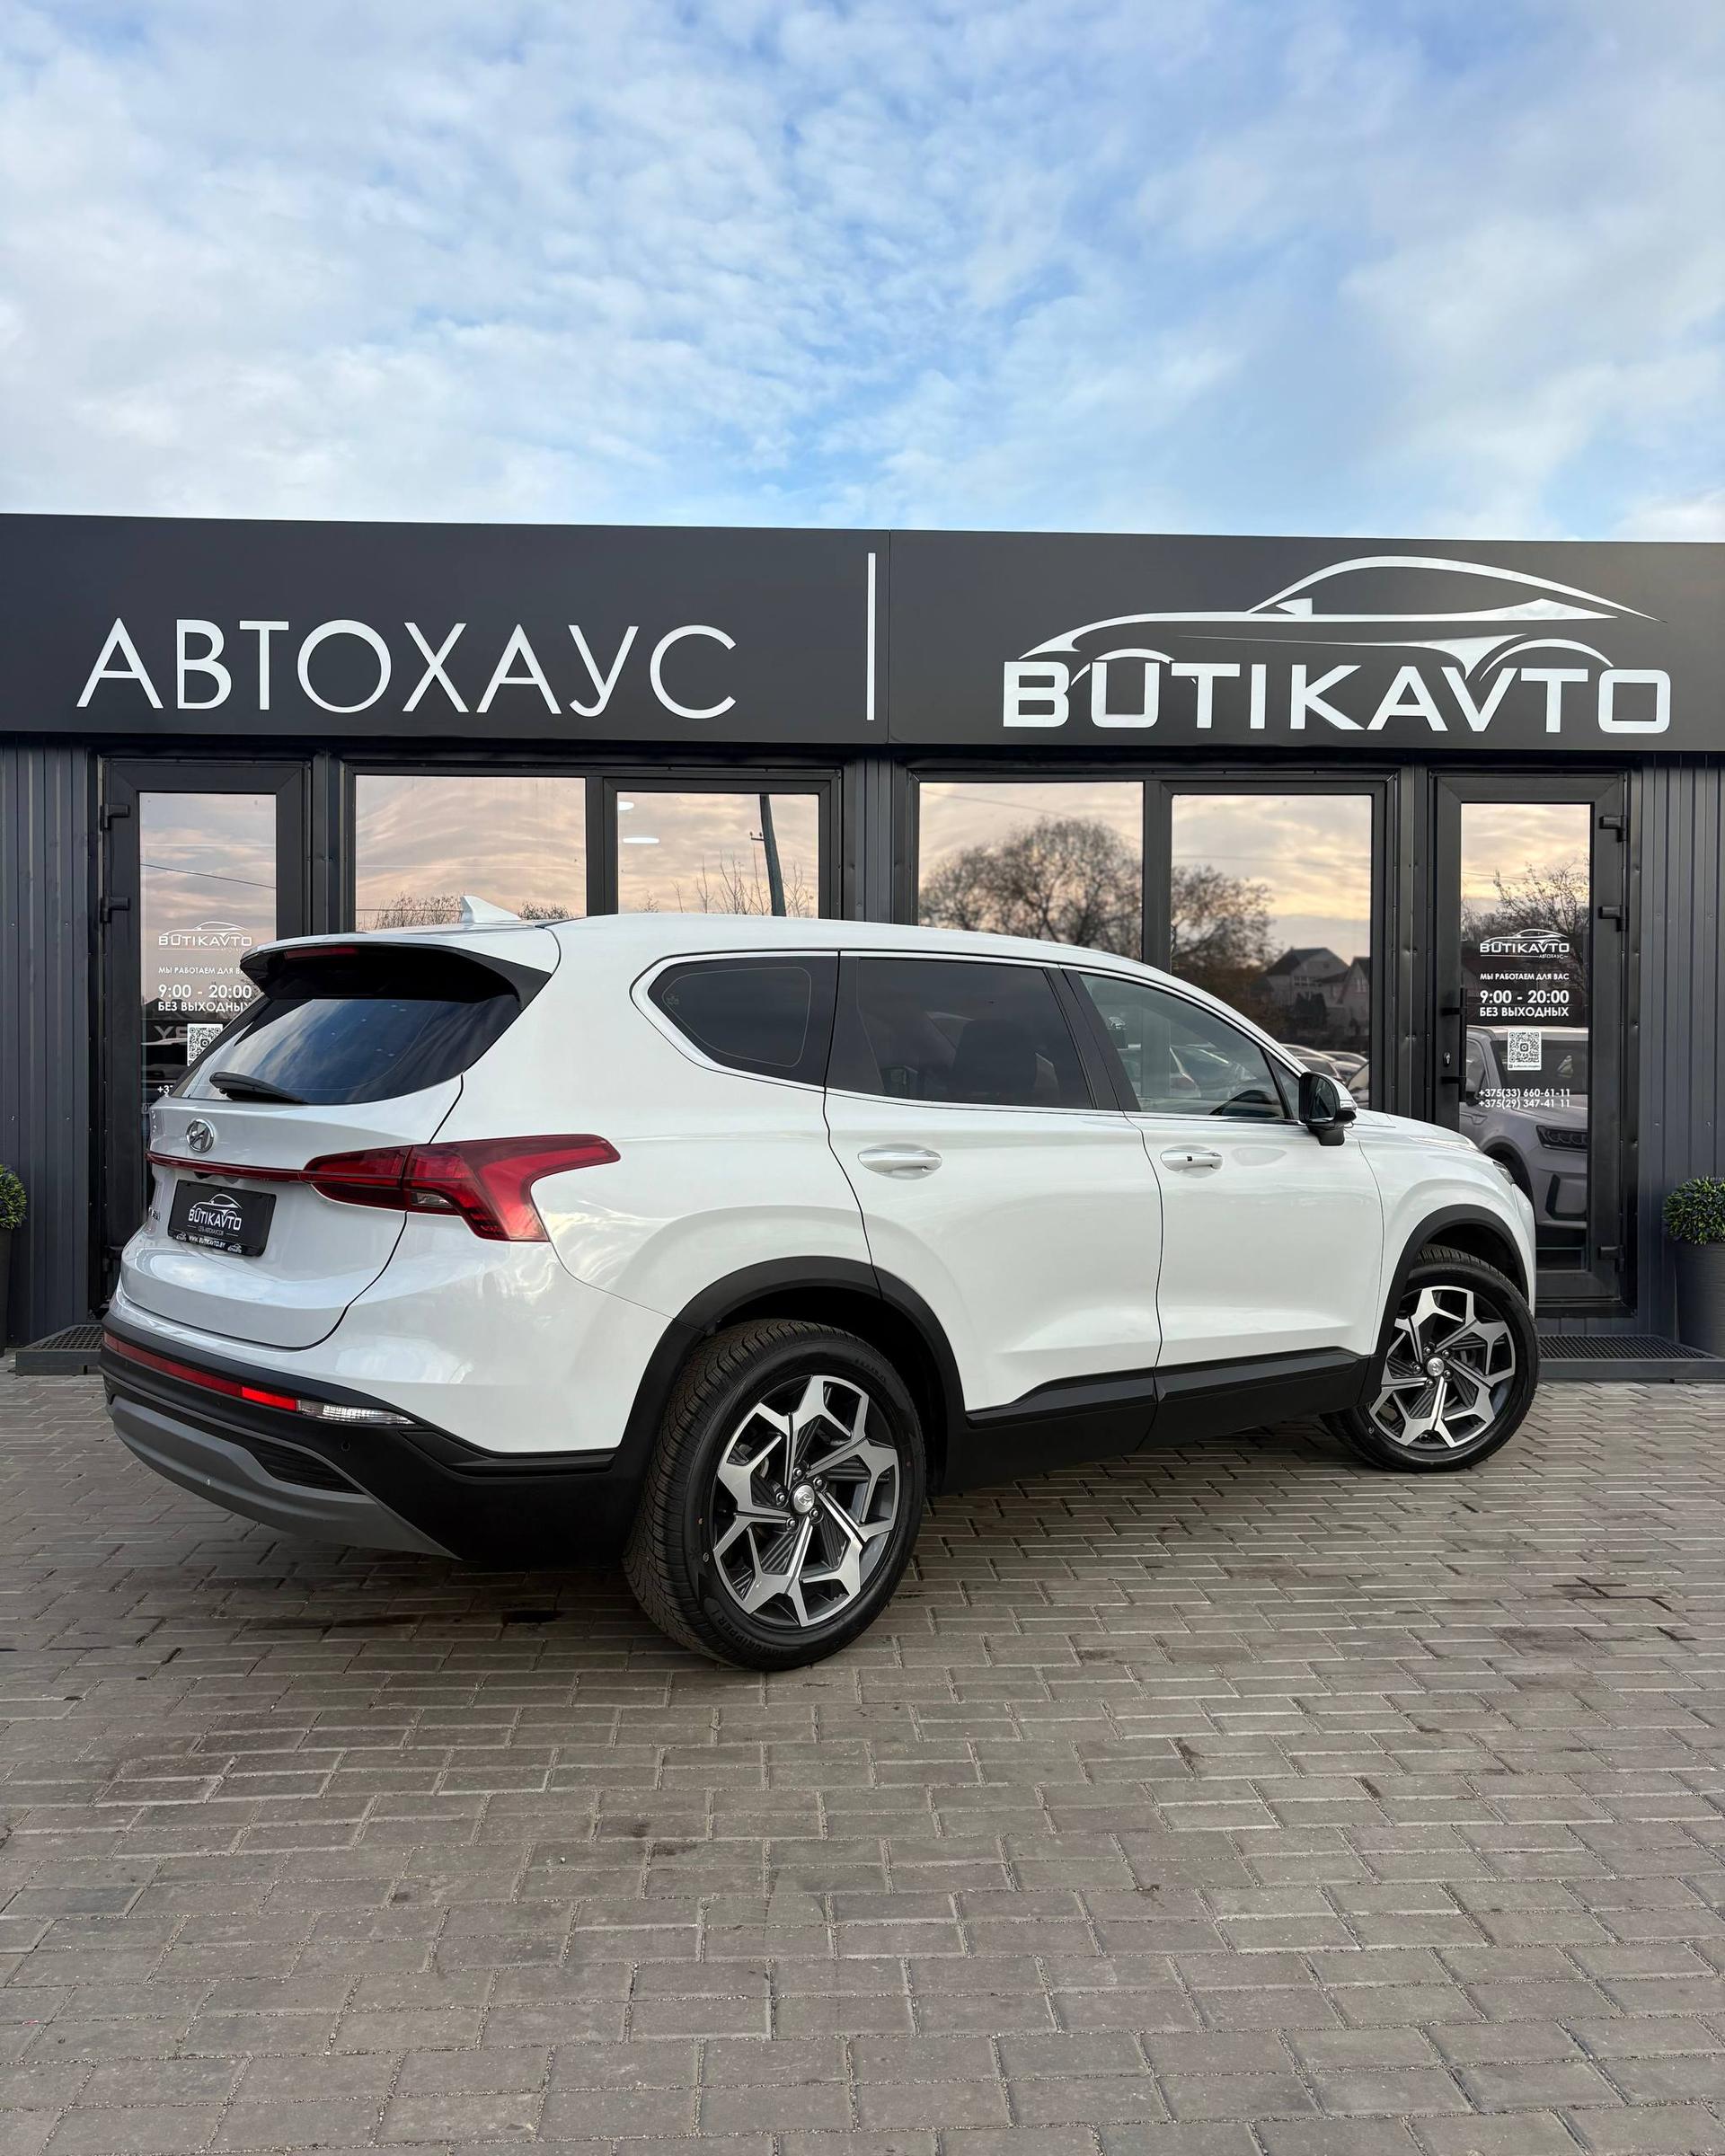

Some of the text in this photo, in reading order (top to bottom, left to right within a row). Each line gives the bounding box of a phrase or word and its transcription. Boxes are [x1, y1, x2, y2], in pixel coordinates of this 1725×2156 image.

[77, 617, 737, 719] АВТОХАУС
[1003, 660, 1671, 734] BUTIKAVTO
[158, 934, 252, 946] BUTIKAVTO
[1480, 942, 1570, 953] BUTIKAVTO
[158, 967, 172, 975] МЫ
[174, 967, 216, 975] РАБОТАЕМ
[217, 967, 234, 976] ДЛЯ
[158, 984, 192, 998] 9:00
[208, 985, 252, 998] 20:00
[1480, 990, 1512, 1004] 9:00
[1527, 990, 1570, 1004] 20:00
[157, 1002, 178, 1012] БЕЗ
[1480, 1006, 1569, 1018] БЕЗ ВЫХОДНЫХ
[1479, 1088, 1570, 1099] +375(33) 660-61-11
[1479, 1099, 1521, 1109] +375(29)
[188, 1208, 243, 1231] BUTIKAVTO
